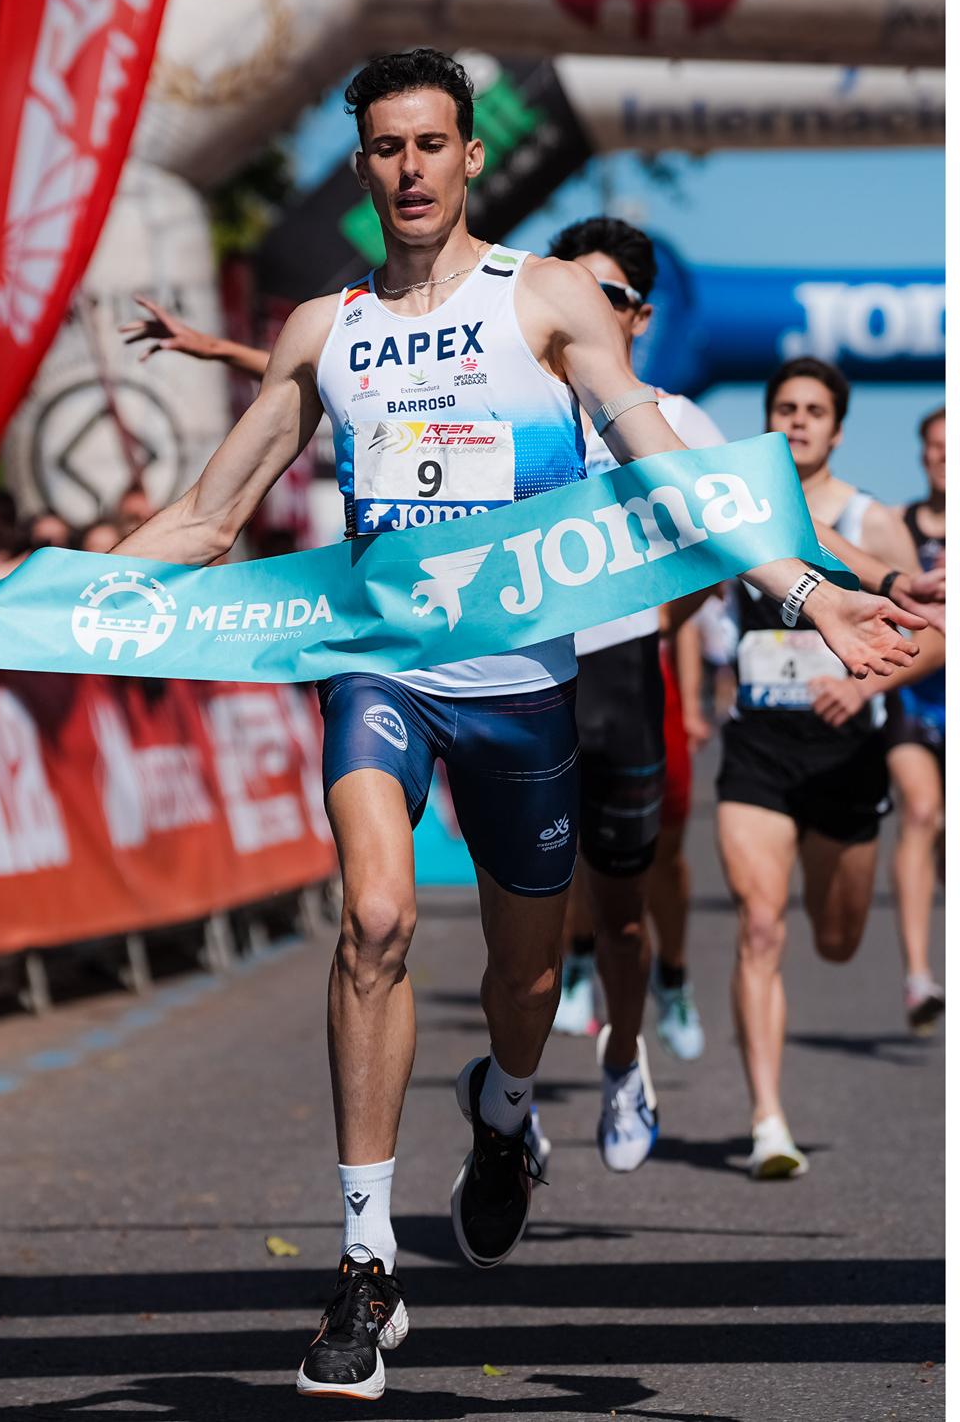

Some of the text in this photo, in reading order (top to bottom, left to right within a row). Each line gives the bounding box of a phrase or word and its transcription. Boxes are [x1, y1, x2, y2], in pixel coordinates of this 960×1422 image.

[349, 321, 484, 373] CAPEX
[400, 384, 440, 394] Extremadura
[460, 378, 487, 387] BADAJOZ
[387, 394, 456, 413] BARROSO
[426, 423, 474, 436] RFEA
[421, 436, 496, 445] ATLETISMO
[417, 460, 443, 498] 9
[499, 473, 772, 615] Joma
[186, 594, 333, 631] MÉRIDA
[214, 630, 303, 643] AYUNTAMIENTO
